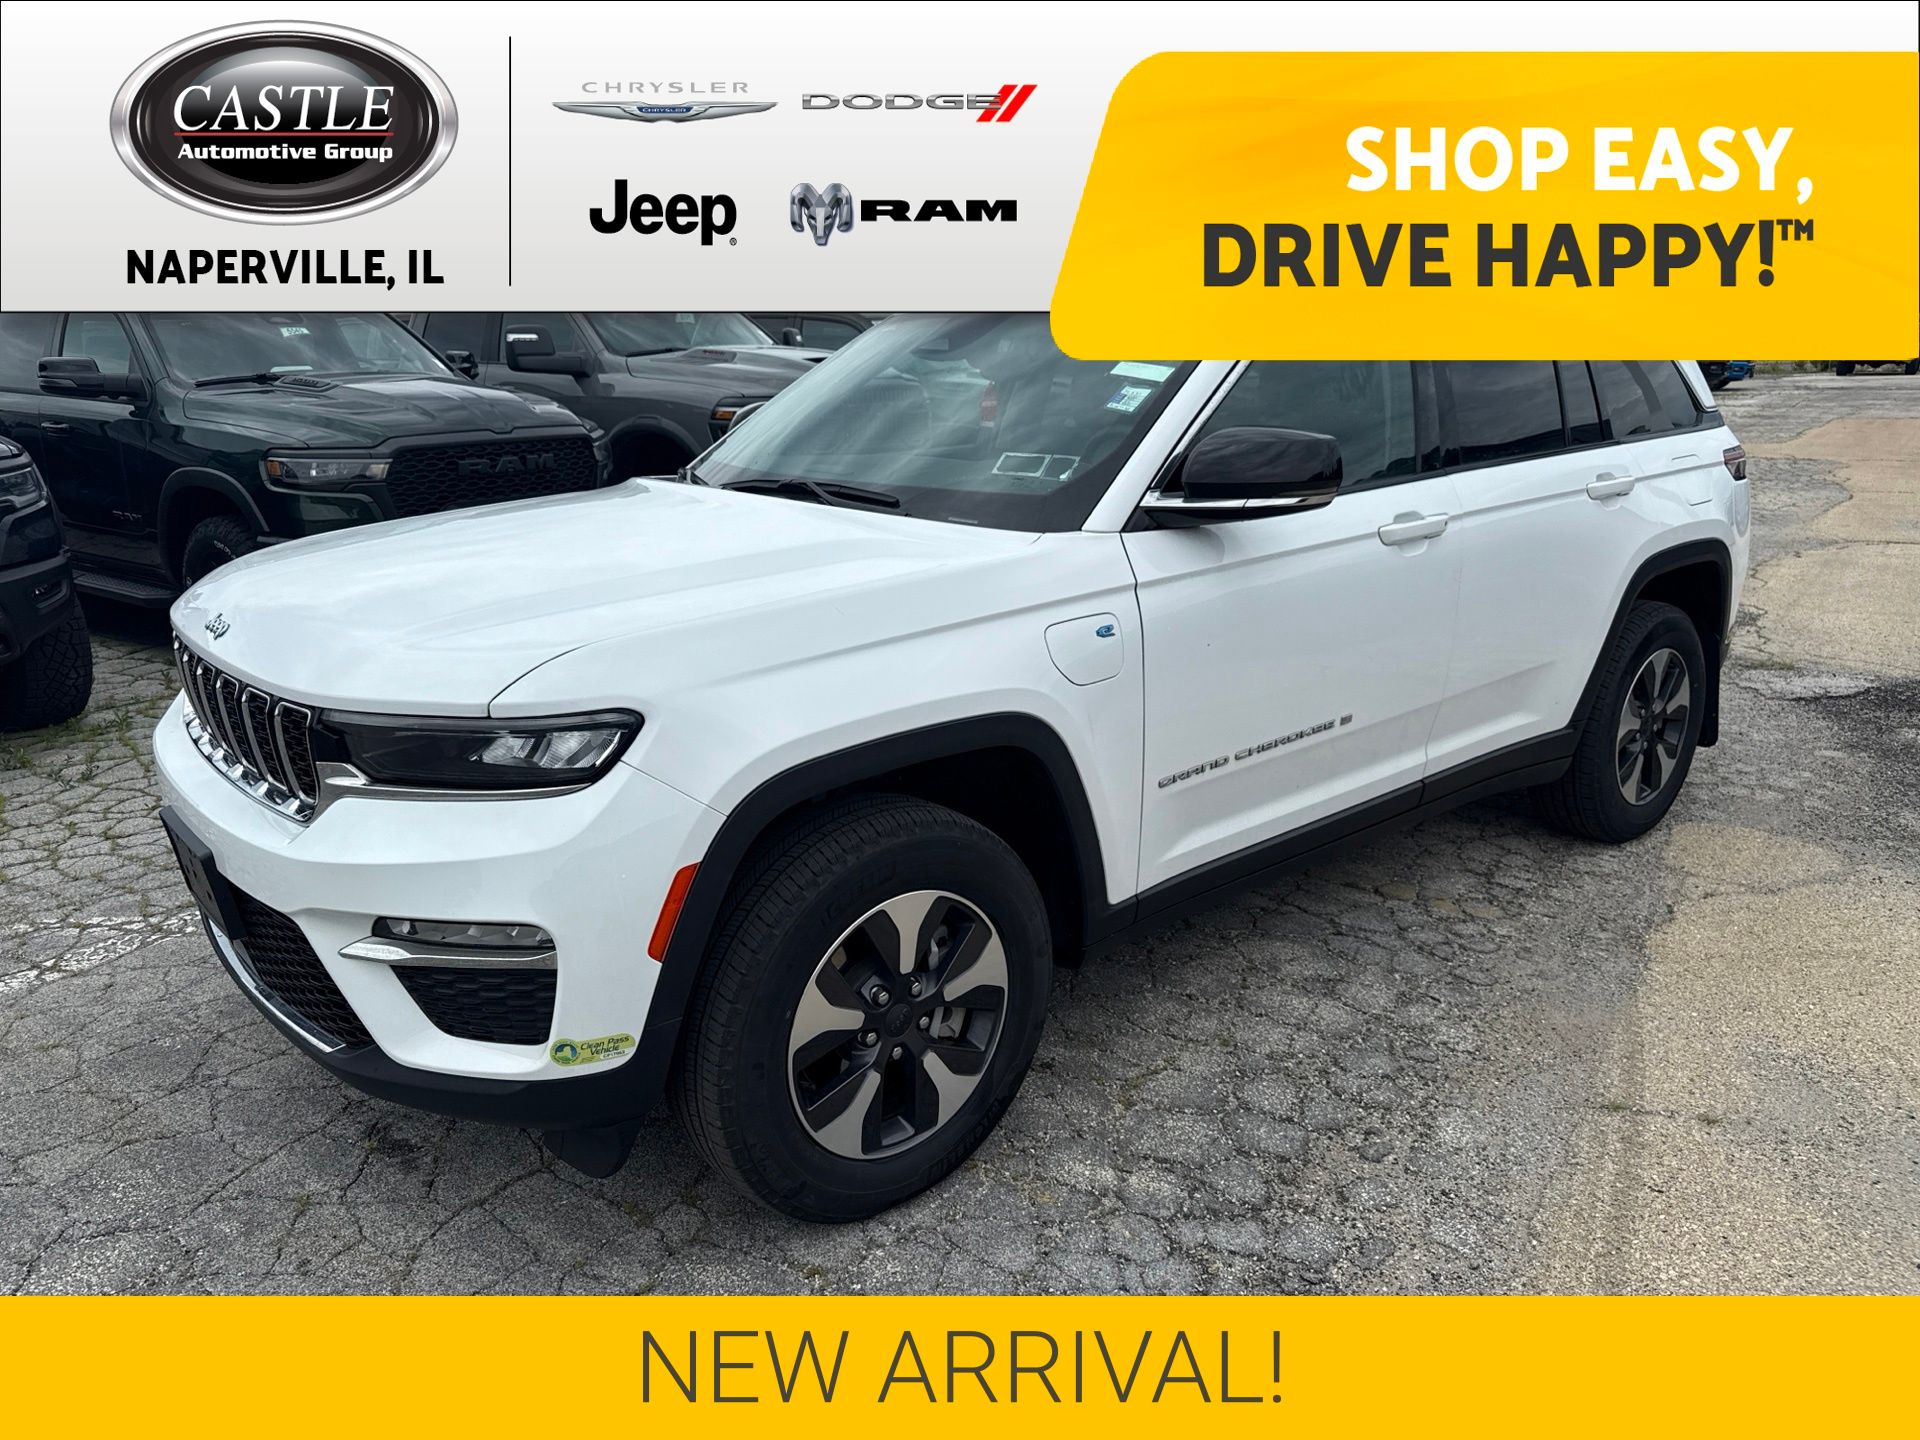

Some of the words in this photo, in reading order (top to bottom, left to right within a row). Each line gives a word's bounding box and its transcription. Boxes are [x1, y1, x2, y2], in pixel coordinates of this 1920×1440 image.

[457, 453, 555, 479] RAM
[1158, 755, 1230, 789] GRAND
[1234, 719, 1336, 762] CHEROKEE
[580, 1040, 605, 1051] Clean
[607, 1035, 630, 1046] Pass
[590, 1044, 620, 1056] Vehicle
